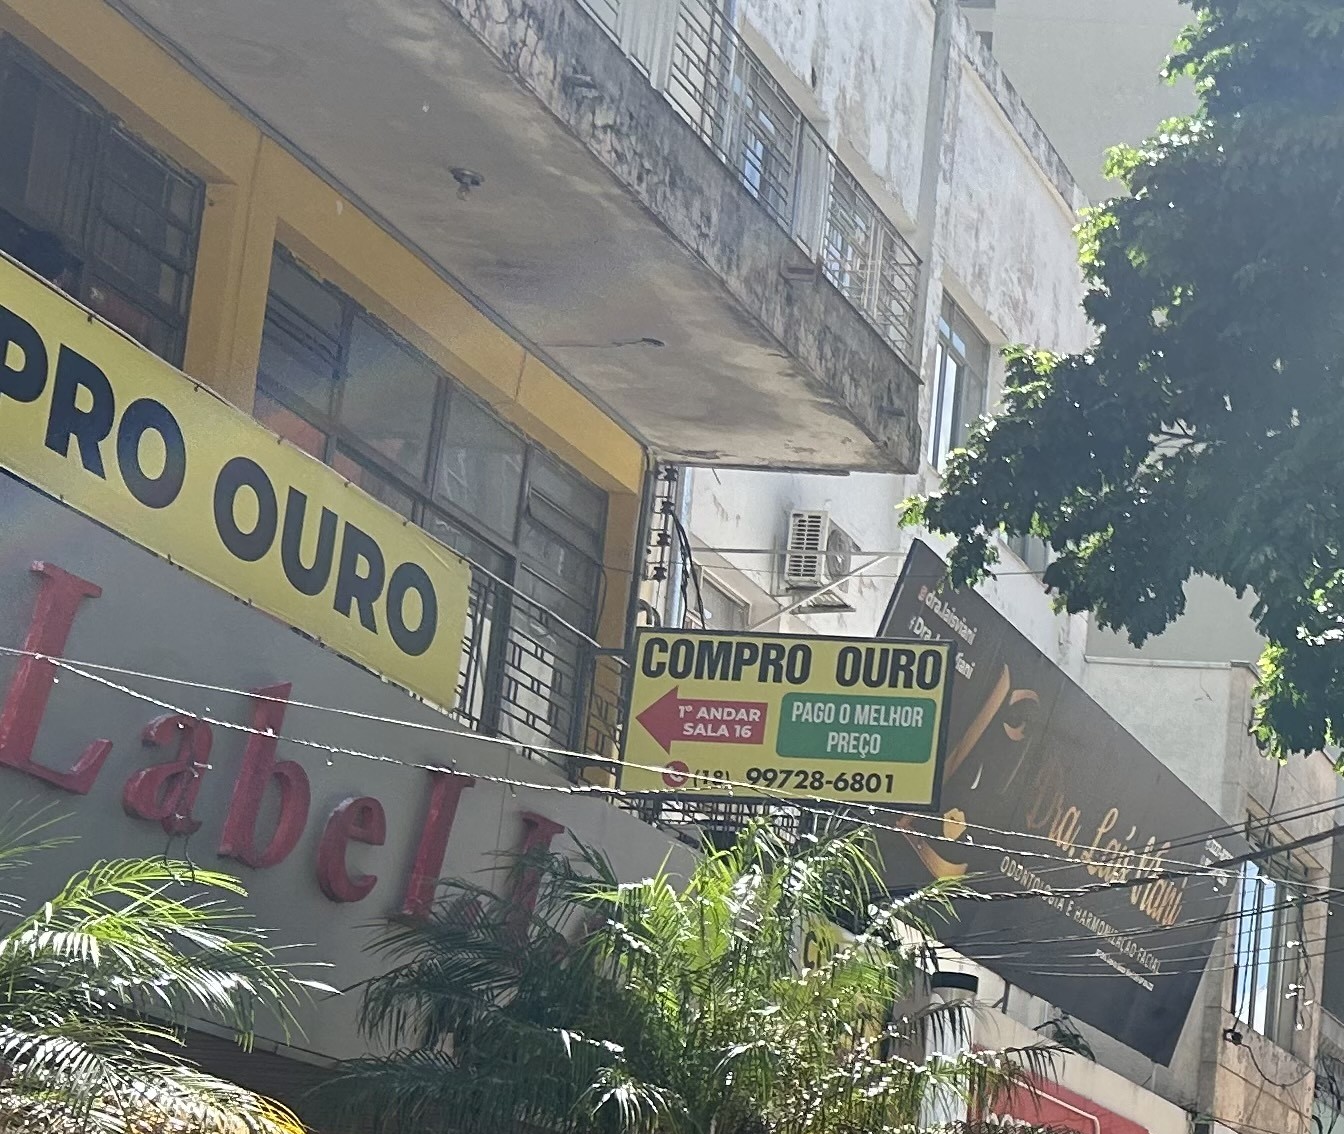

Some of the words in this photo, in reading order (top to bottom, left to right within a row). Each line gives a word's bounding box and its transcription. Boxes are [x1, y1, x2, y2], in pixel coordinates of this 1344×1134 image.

[213, 456, 438, 657] OURO
[641, 637, 812, 685] COMPRO
[836, 646, 943, 691] OURO
[696, 706, 761, 722] ANDAR
[791, 702, 834, 724] PAGO
[839, 704, 851, 725] O
[854, 705, 924, 728] MELHOR
[682, 722, 730, 738] SALA
[735, 724, 753, 738] 16
[827, 733, 881, 758] PREÇO
[745, 766, 895, 794] 99728-6801
